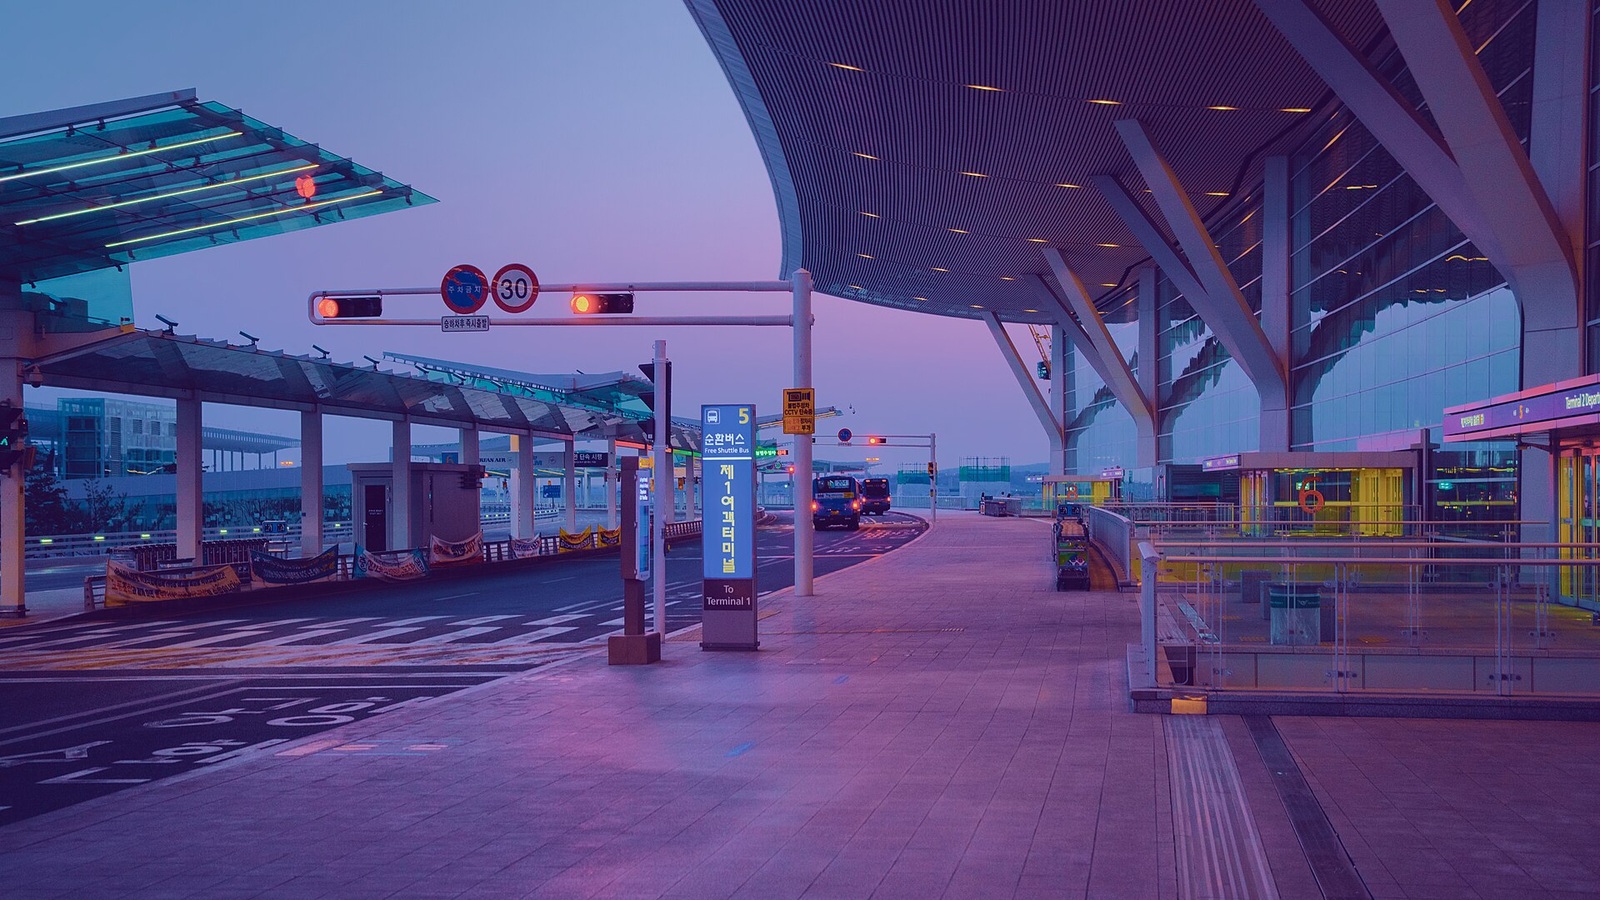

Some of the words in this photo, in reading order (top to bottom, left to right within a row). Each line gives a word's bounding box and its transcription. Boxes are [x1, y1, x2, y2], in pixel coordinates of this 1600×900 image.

[448, 286, 482, 294] 주차금지
[500, 278, 528, 300] 30
[443, 319, 465, 328] 승하차후
[466, 318, 487, 328] 즉시출발
[1565, 393, 1581, 409] Terminal
[738, 407, 749, 425] 5
[1519, 404, 1523, 419] 5
[704, 433, 745, 447] 순환버스
[1067, 485, 1078, 501] 8
[1299, 476, 1325, 514] 6
[720, 464, 736, 573] 제1여객터미널
[723, 584, 734, 594] To
[706, 596, 744, 606] Terminal
[746, 596, 751, 606] 1
